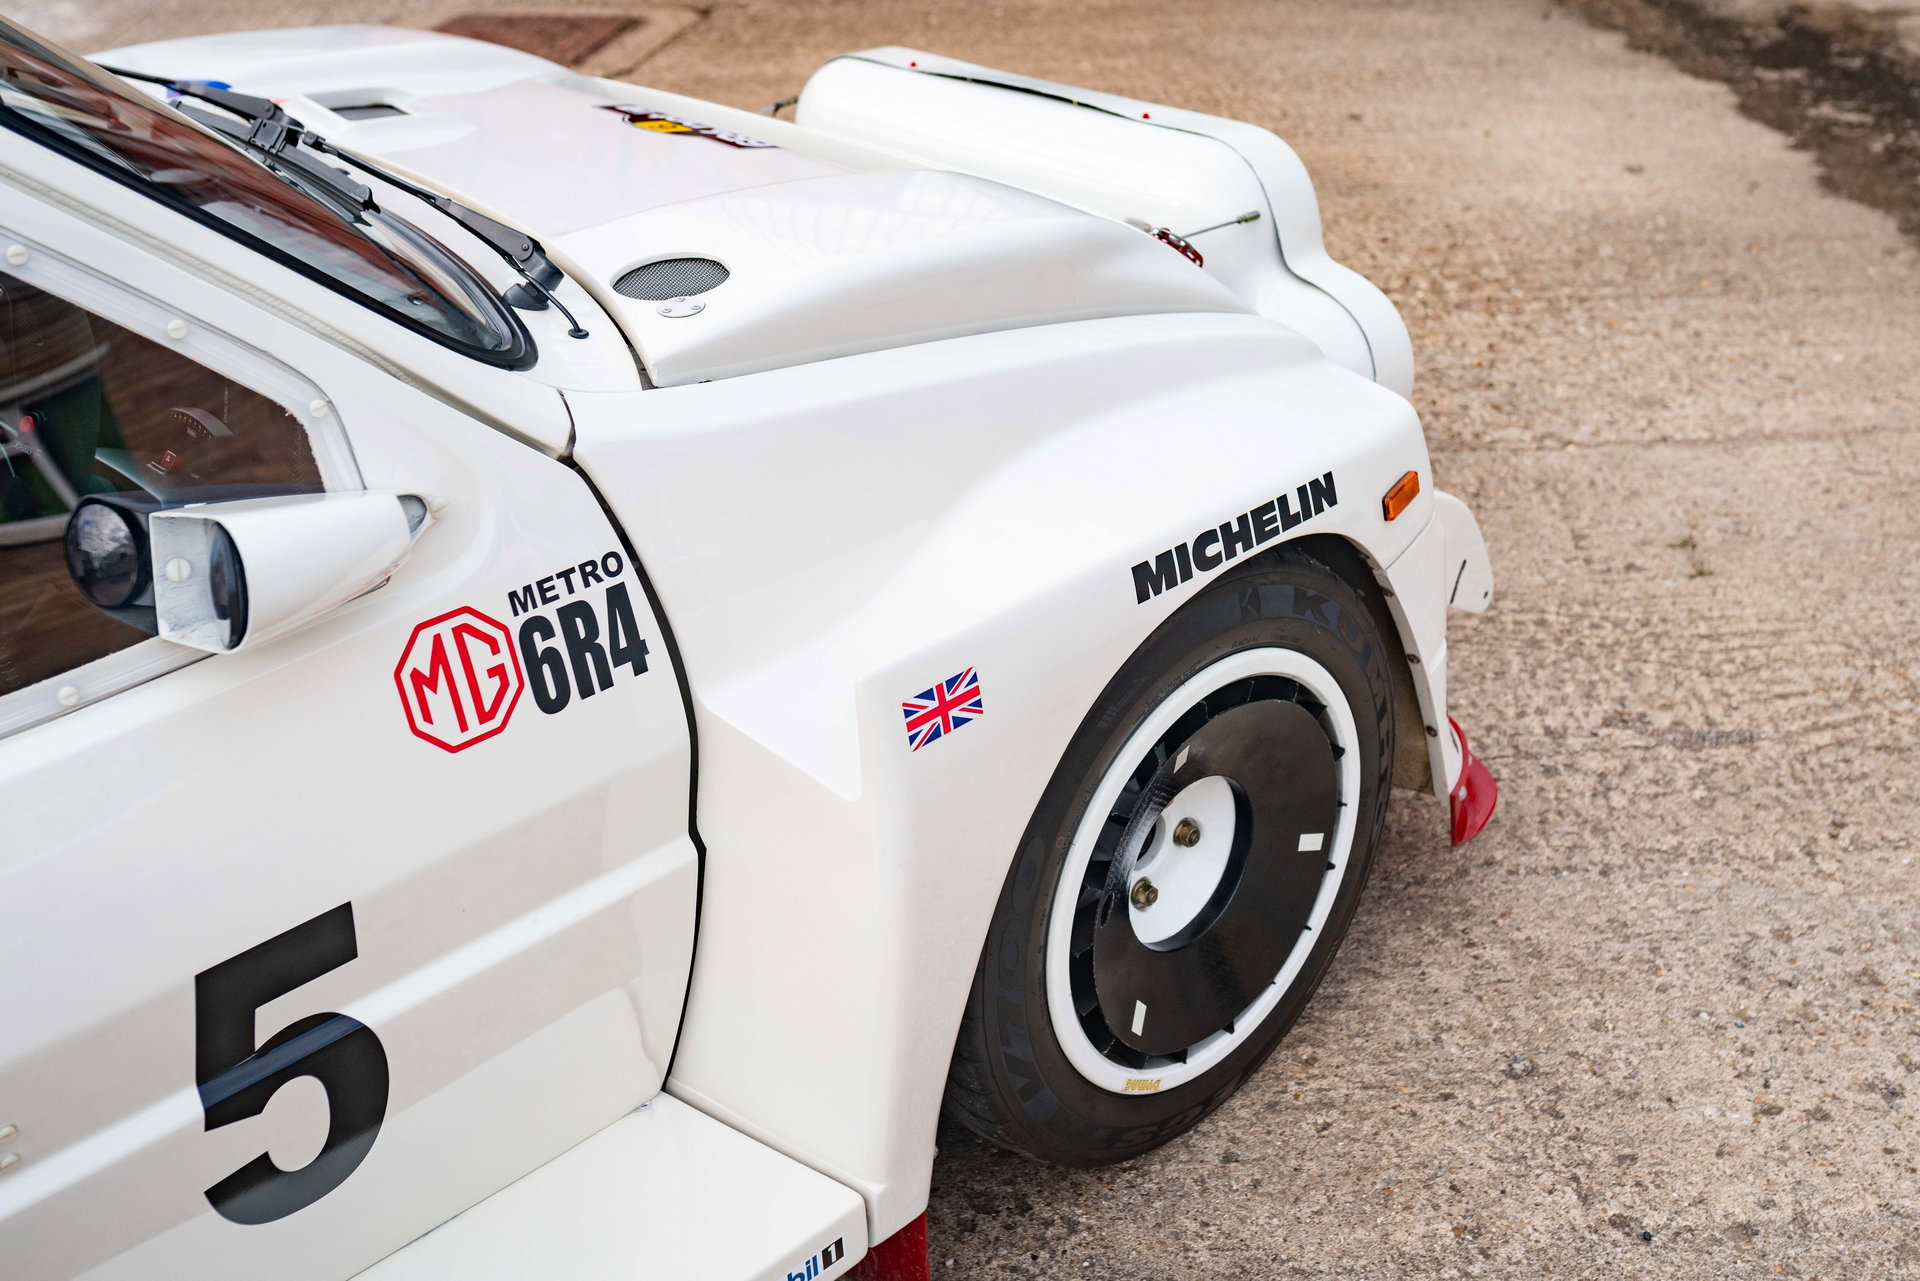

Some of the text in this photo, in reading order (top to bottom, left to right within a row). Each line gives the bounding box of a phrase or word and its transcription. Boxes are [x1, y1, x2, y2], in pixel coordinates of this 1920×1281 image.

[507, 551, 624, 617] METRO
[1131, 471, 1338, 605] MICHELIN
[409, 621, 511, 734] MG
[518, 581, 650, 715] 6R4
[195, 900, 390, 1225] 5
